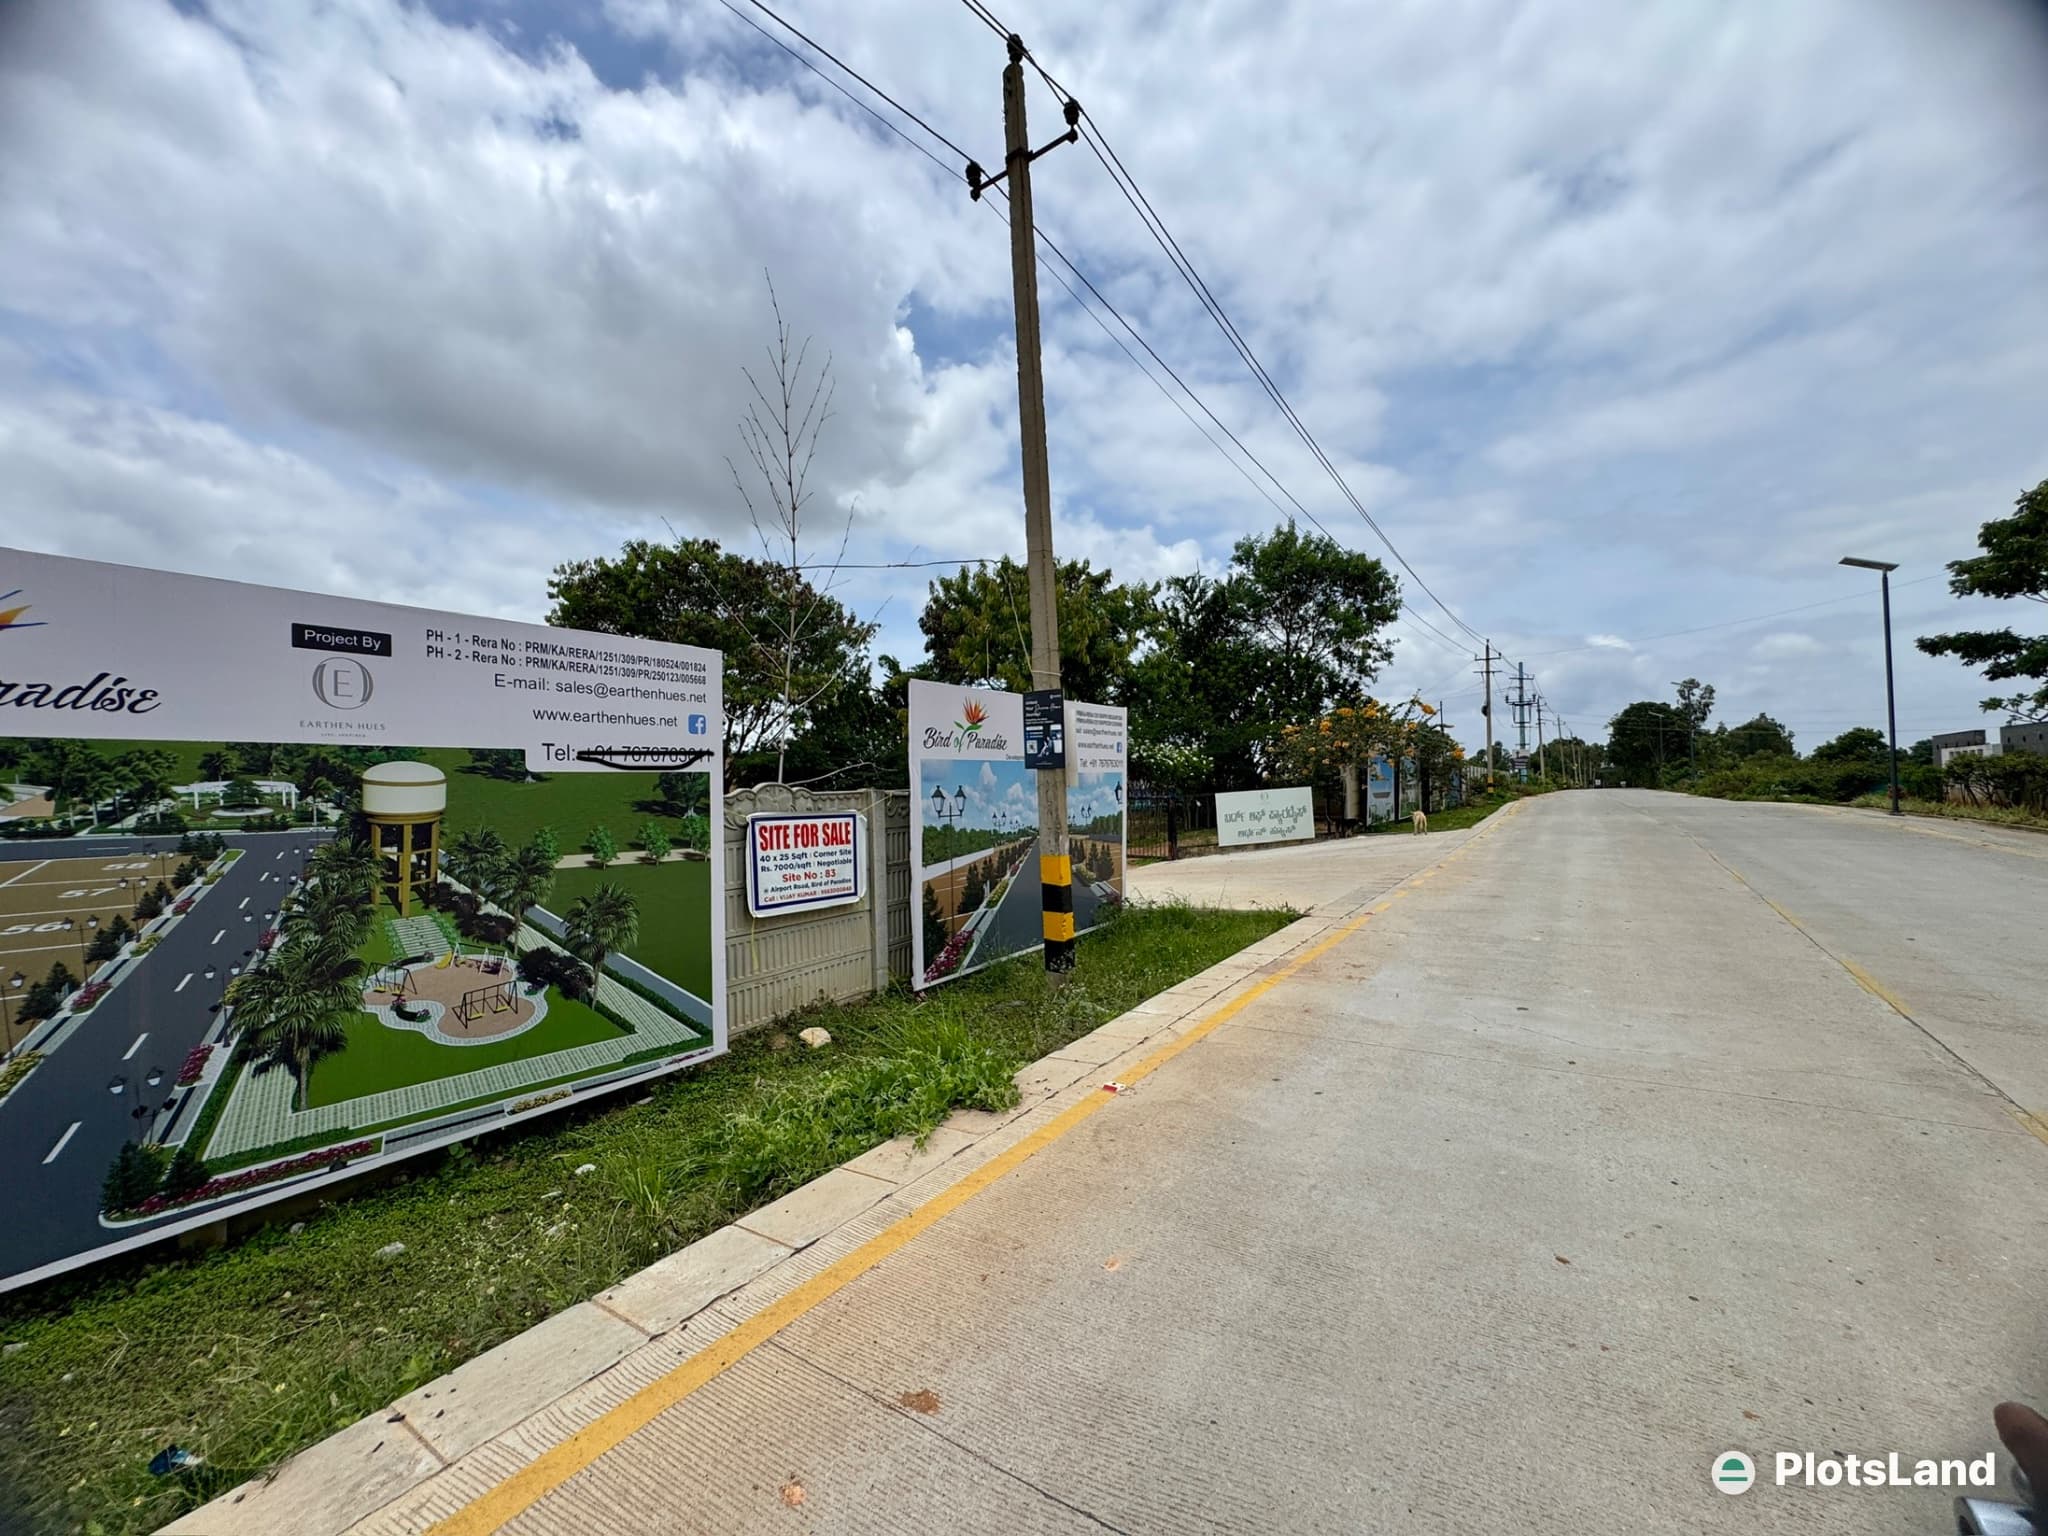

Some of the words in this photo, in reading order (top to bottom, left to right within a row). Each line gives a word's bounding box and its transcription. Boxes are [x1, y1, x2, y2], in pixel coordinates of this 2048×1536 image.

[304, 629, 358, 646] Project
[362, 636, 382, 652] By
[426, 629, 444, 643] PH
[454, 633, 461, 645] 1
[472, 635, 498, 649] Rera
[501, 638, 516, 651] No
[426, 645, 444, 659] PH
[454, 649, 462, 661] 2
[472, 651, 498, 665] Rera
[501, 654, 516, 666] No
[494, 673, 551, 692] E-mail:
[555, 680, 707, 704] sales@earthenhues.net
[299, 719, 353, 729] EARTHEN
[358, 722, 386, 731] HUES
[532, 709, 678, 728] www.earthenhues.net
[922, 726, 954, 750] Bird
[966, 731, 1008, 751] Paradise
[541, 742, 575, 762] Tel:
[758, 824, 791, 852] SITE
[794, 823, 819, 849] FOR
[822, 821, 852, 848] SALE
[760, 855, 771, 863] 40
[779, 853, 790, 861] 25
[791, 852, 808, 861] Sqft
[813, 850, 838, 858] Corner
[760, 865, 773, 873] Rs.
[774, 862, 812, 872] 7000/sqft
[816, 857, 852, 867] Negotiable
[782, 872, 802, 883] Site
[804, 871, 818, 881] No
[824, 869, 837, 878] 83
[770, 884, 793, 893] Airport
